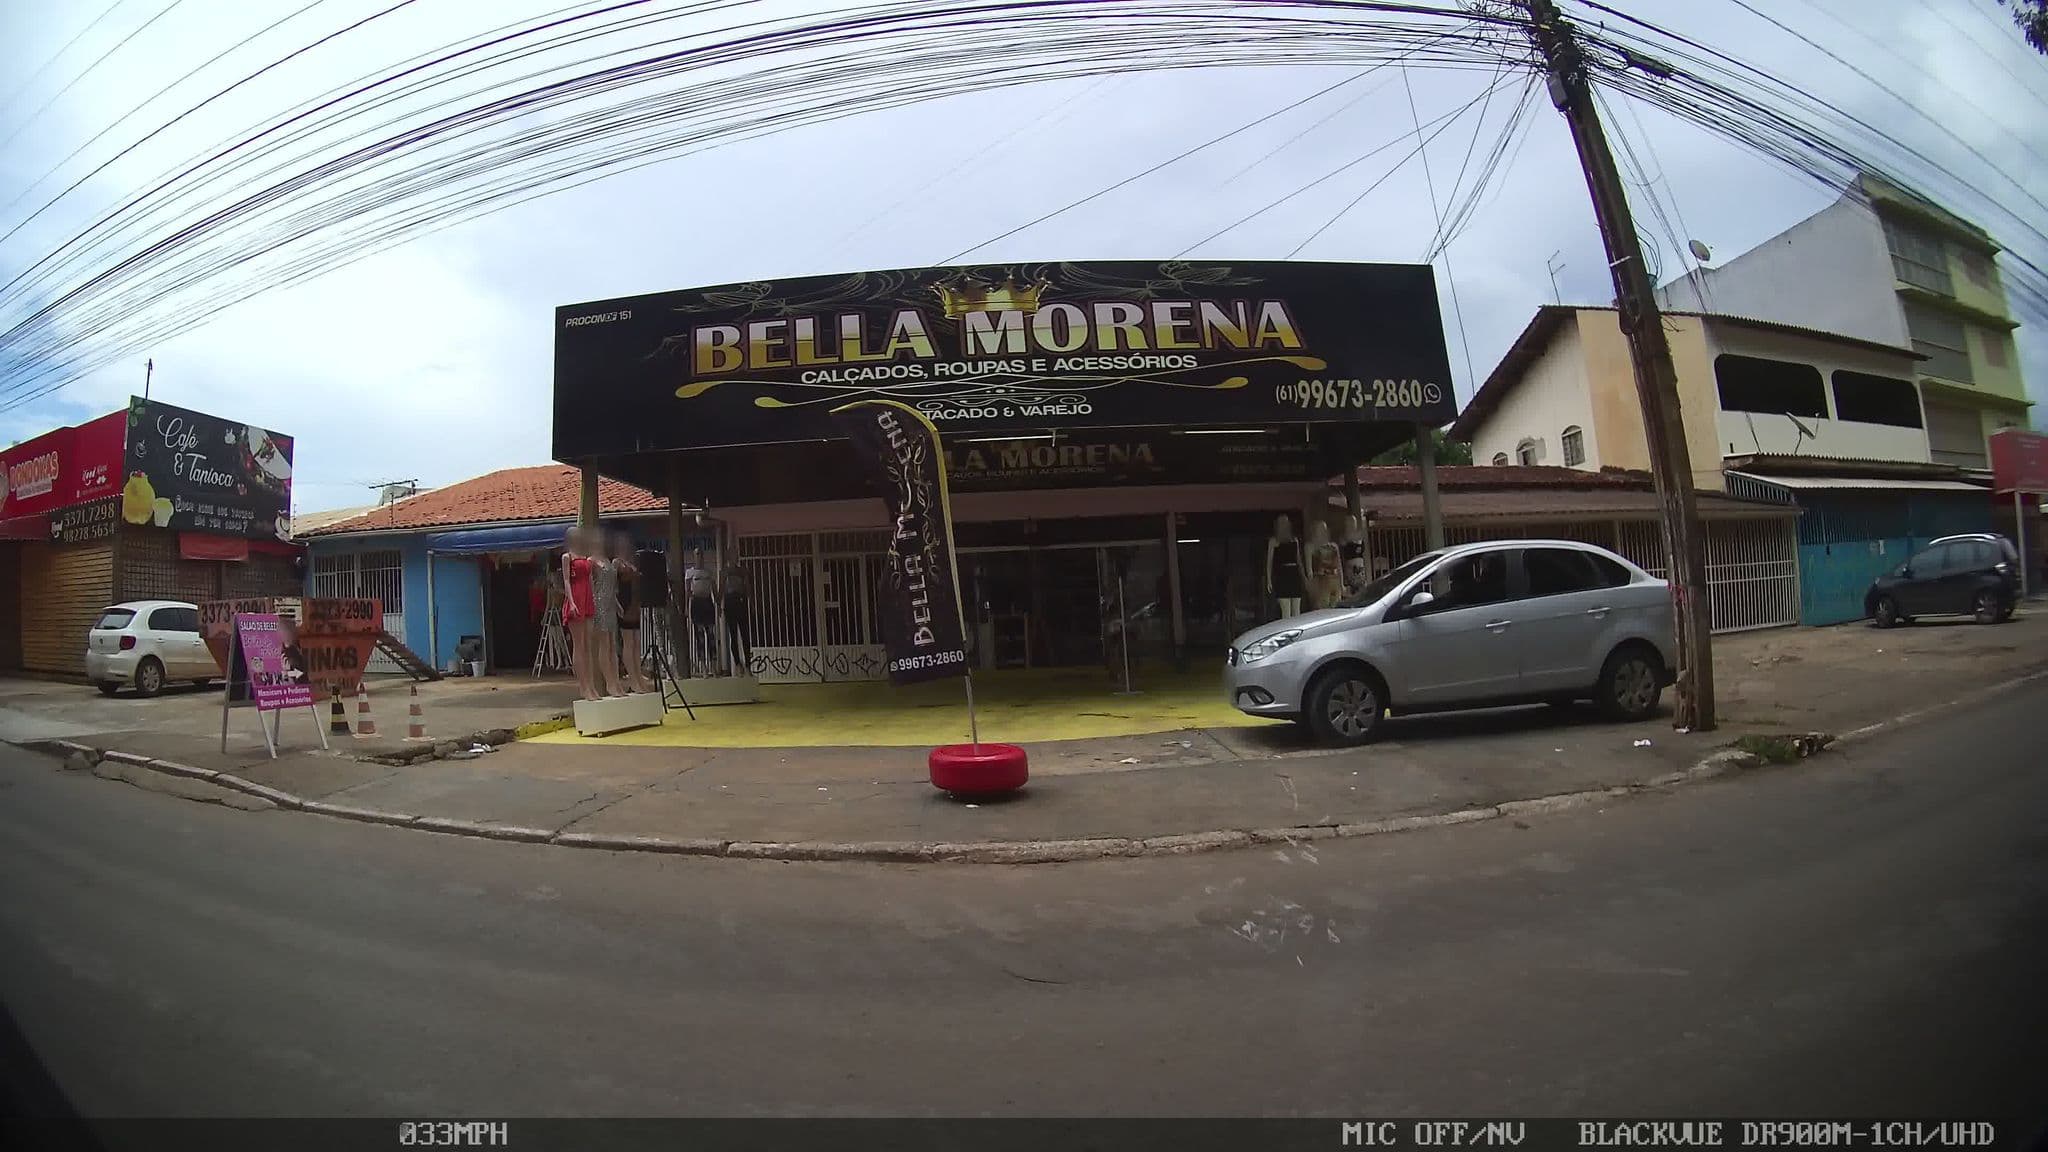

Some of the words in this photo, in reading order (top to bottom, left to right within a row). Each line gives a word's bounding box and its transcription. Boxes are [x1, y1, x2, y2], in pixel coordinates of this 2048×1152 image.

[618, 310, 632, 320] 151
[693, 309, 936, 375] BELLA
[965, 301, 1304, 356] MORENA
[801, 364, 928, 385] CALÇADOS,
[934, 360, 1026, 376] ROUPAS
[1032, 358, 1047, 372] E
[1053, 352, 1198, 371] ACESSÓRIOS
[922, 407, 998, 420] TACADO
[1003, 406, 1015, 417] &
[1019, 403, 1093, 417] VAREJO
[173, 452, 184, 476] &
[185, 453, 234, 487] Tapioca
[1000, 442, 1156, 469] MORENA
[904, 553, 935, 648] BELLA
[898, 649, 964, 671] 99673-2860
